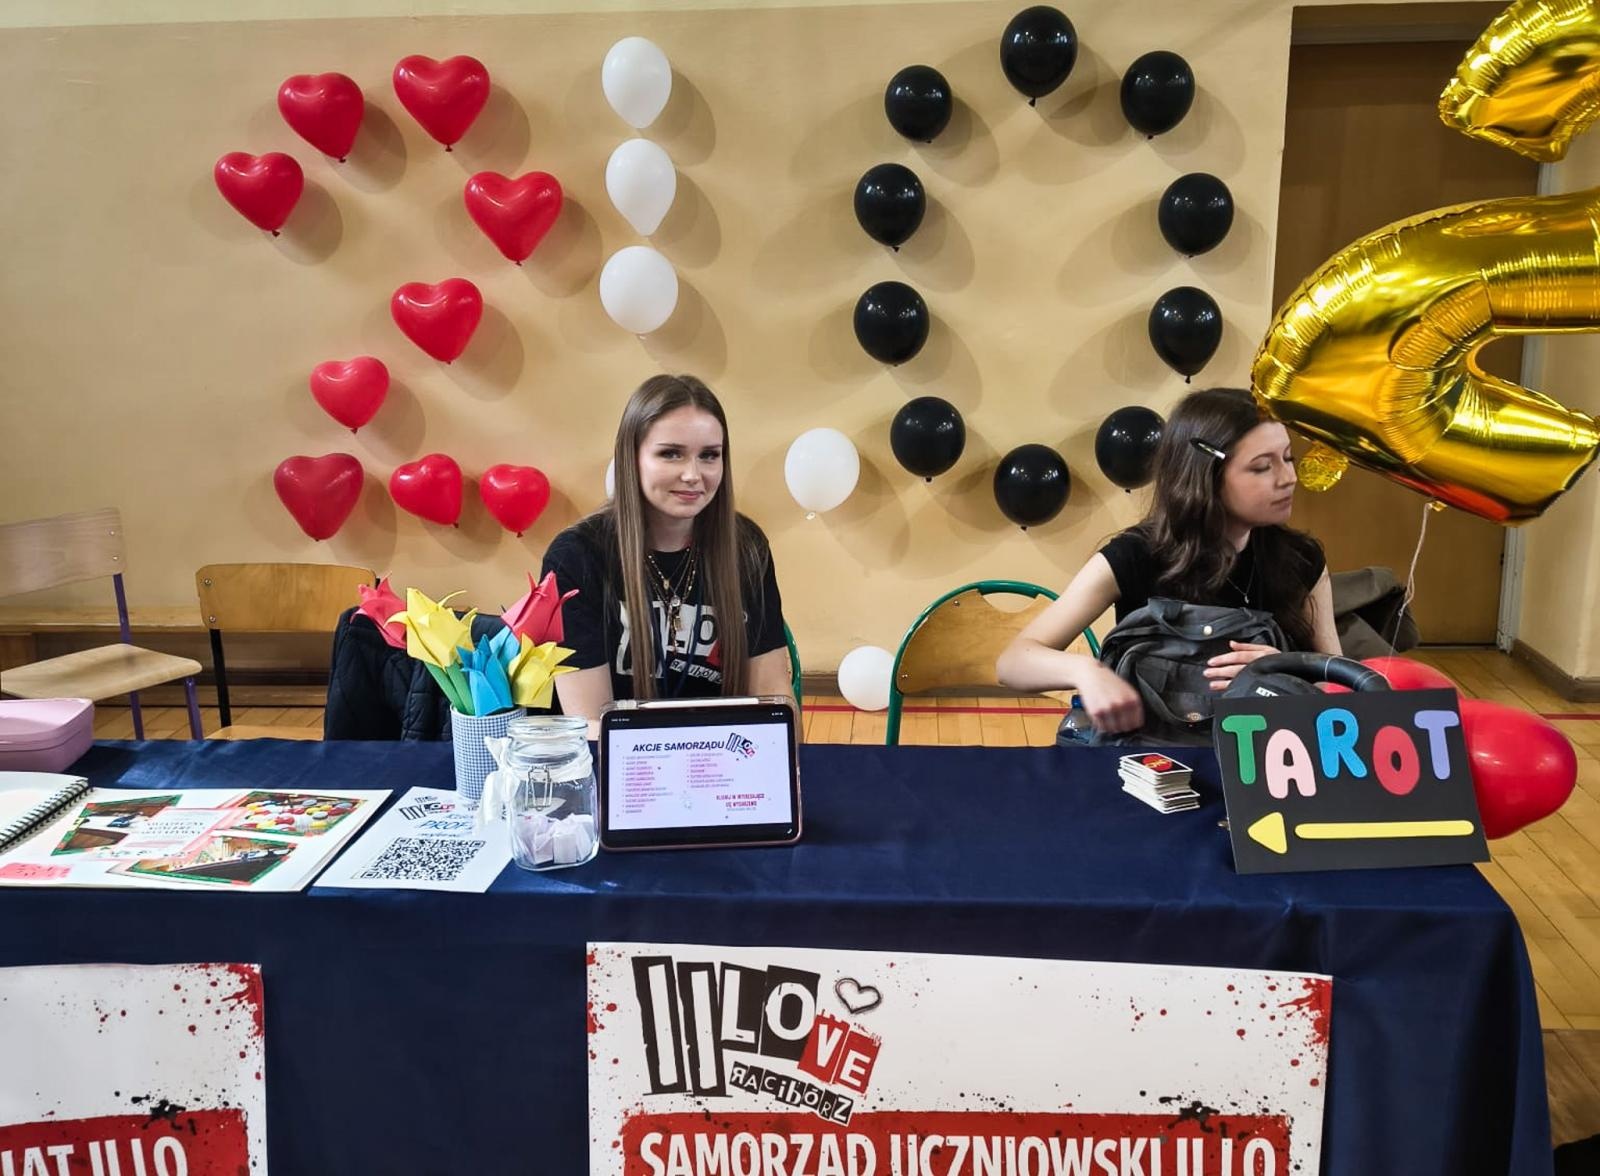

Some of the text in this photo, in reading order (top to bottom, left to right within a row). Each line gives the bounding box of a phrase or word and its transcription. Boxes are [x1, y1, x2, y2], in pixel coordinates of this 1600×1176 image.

[632, 742, 662, 752] AKCJE
[1221, 708, 1460, 799] TAROT
[890, 1133, 1163, 1176] UCZNIOWSKI
